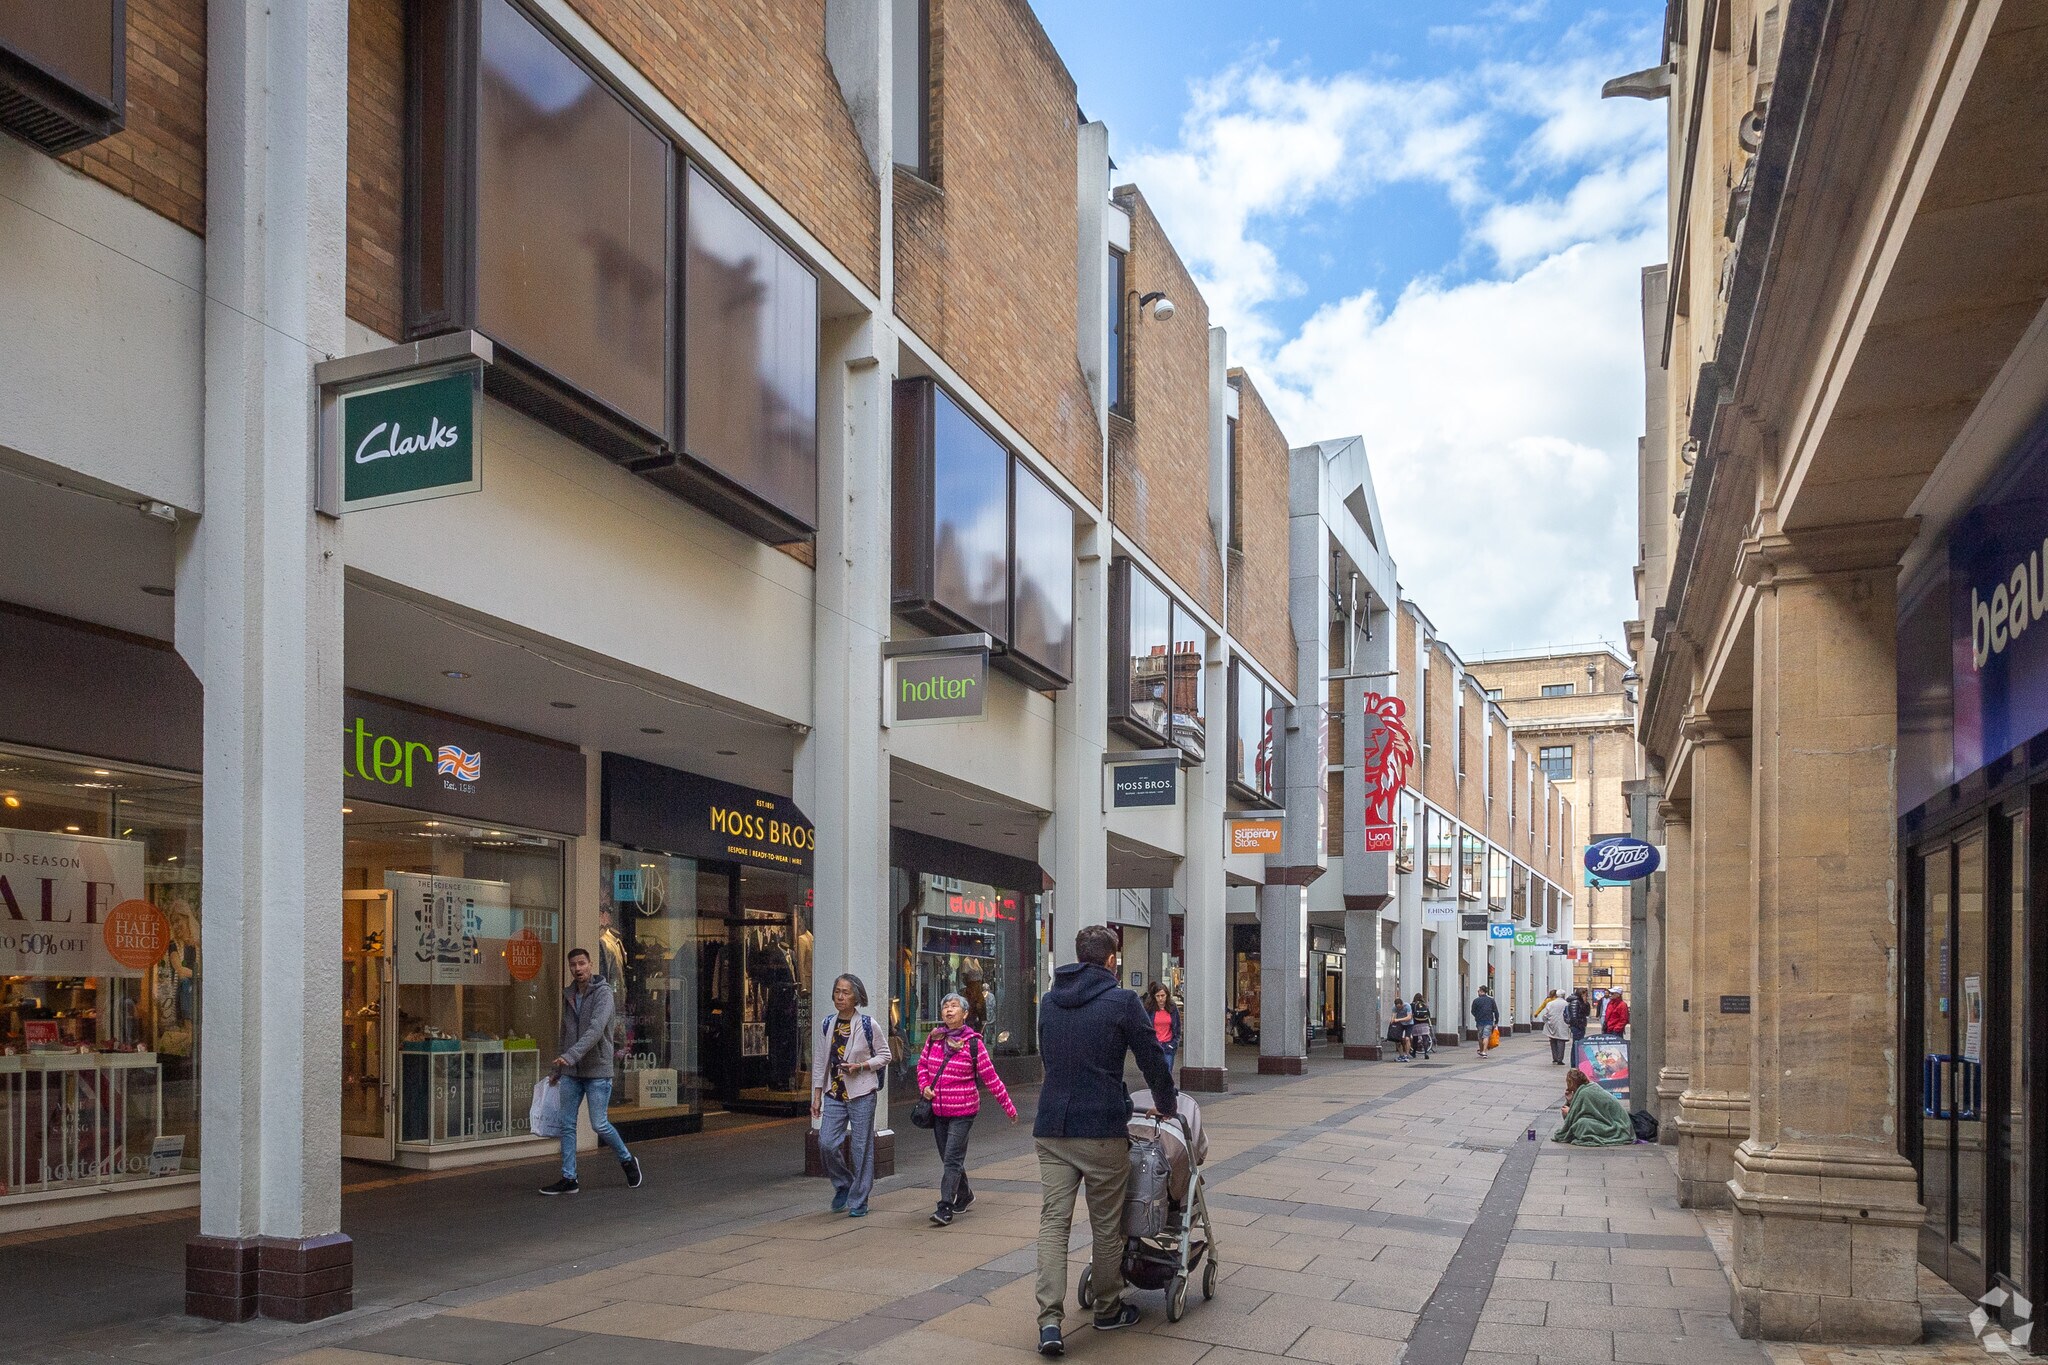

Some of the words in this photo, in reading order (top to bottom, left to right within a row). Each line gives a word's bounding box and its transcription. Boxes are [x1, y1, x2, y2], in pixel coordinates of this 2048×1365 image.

[355, 416, 458, 464] Clarks
[1972, 537, 2048, 671] beau
[902, 676, 976, 702] hotter
[1117, 782, 1142, 791] MOSS
[1145, 780, 1173, 789] BROS.
[711, 806, 765, 840] MOSS
[1234, 828, 1278, 840] Superdry
[1368, 831, 1390, 841] Lion
[1234, 838, 1260, 848] Store.
[1368, 840, 1392, 850] yard
[728, 846, 748, 856] BESPOKE
[752, 850, 788, 863] READY-TO-WEAR
[1592, 845, 1649, 872] Boots
[418, 880, 431, 888] THE
[433, 882, 462, 891] SCIENCE
[0, 874, 115, 924] ALE
[115, 921, 160, 936] HALF
[19, 933, 57, 955] 50%
[60, 939, 88, 951] OFF
[115, 935, 160, 949] PRICE
[512, 945, 537, 956] HALF
[512, 956, 537, 966] PRICE
